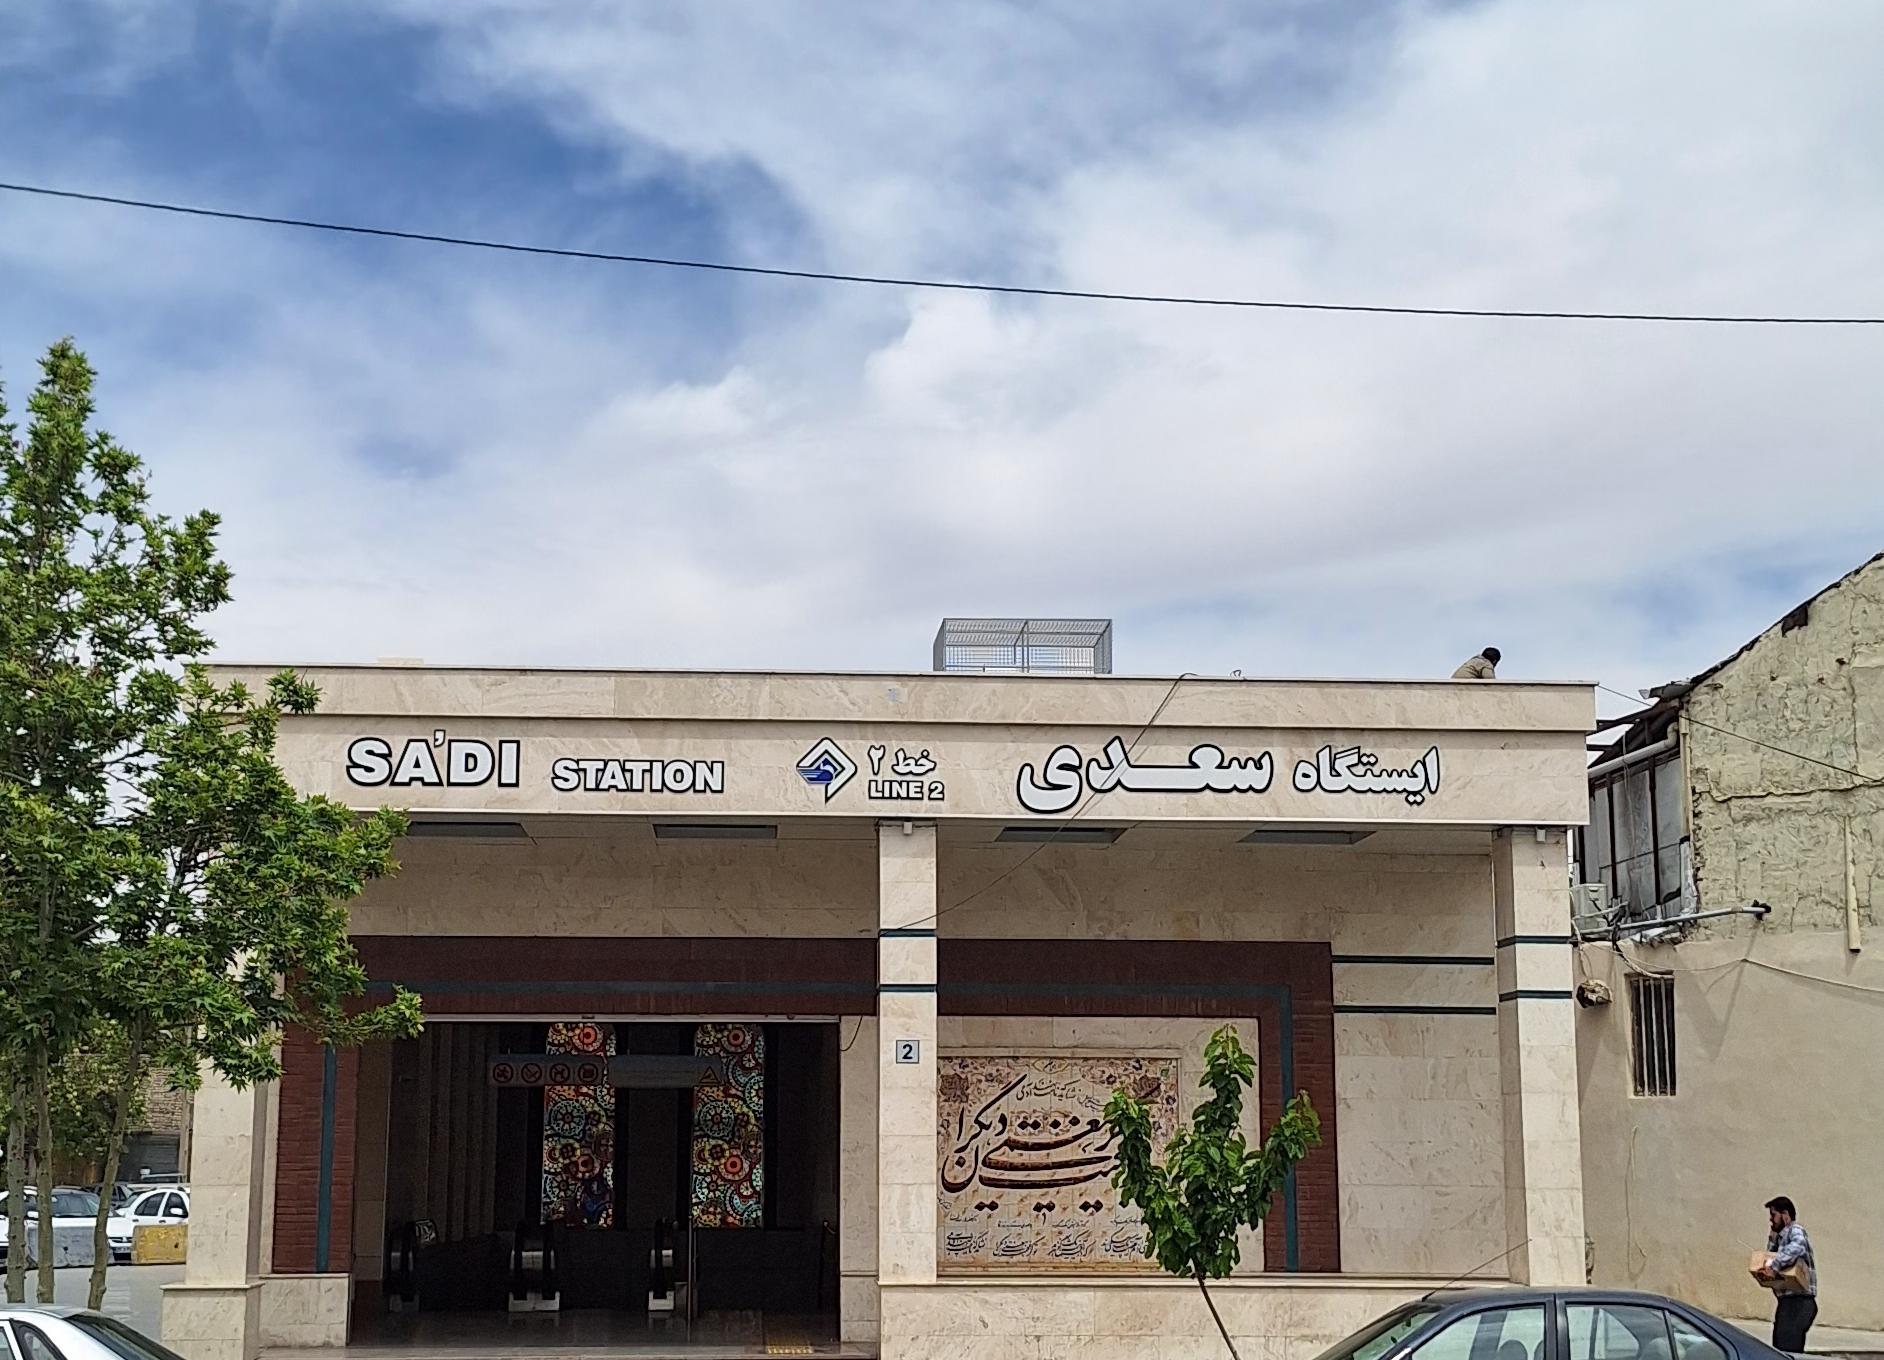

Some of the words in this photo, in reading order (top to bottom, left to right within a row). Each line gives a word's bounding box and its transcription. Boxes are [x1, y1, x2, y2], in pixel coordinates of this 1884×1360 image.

[346, 729, 521, 788] SA'DI
[551, 757, 725, 794] STATION
[891, 747, 937, 776] خط
[1016, 736, 1274, 814] سعدی
[1292, 744, 1441, 806] ایستگاه
[868, 779, 924, 800] LINE
[928, 780, 945, 801] 2
[902, 1043, 913, 1060] 2
